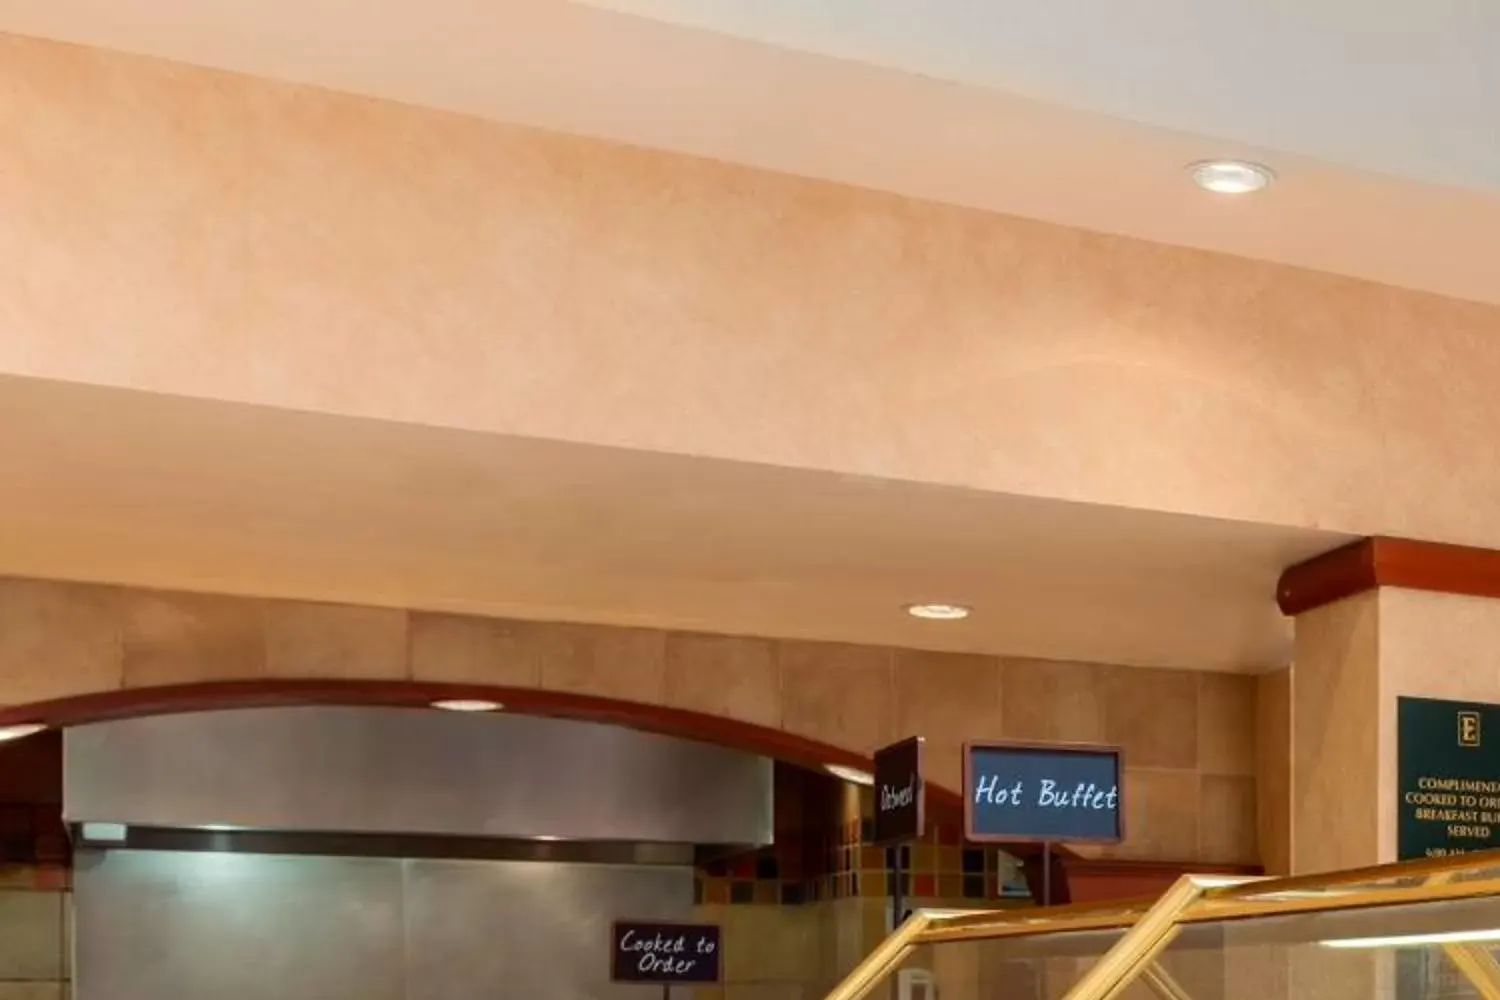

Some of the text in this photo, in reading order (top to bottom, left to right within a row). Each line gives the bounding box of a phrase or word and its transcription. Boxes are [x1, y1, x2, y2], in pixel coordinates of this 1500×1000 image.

[975, 775, 1118, 810] Hot Buffet
[1405, 791, 1457, 806] COOKED
[1459, 795, 1477, 807] TO
[1415, 808, 1478, 822] BREAKFAST
[1447, 824, 1491, 838] SERVED
[620, 929, 716, 953] Cooked to
[638, 953, 697, 974] Order
